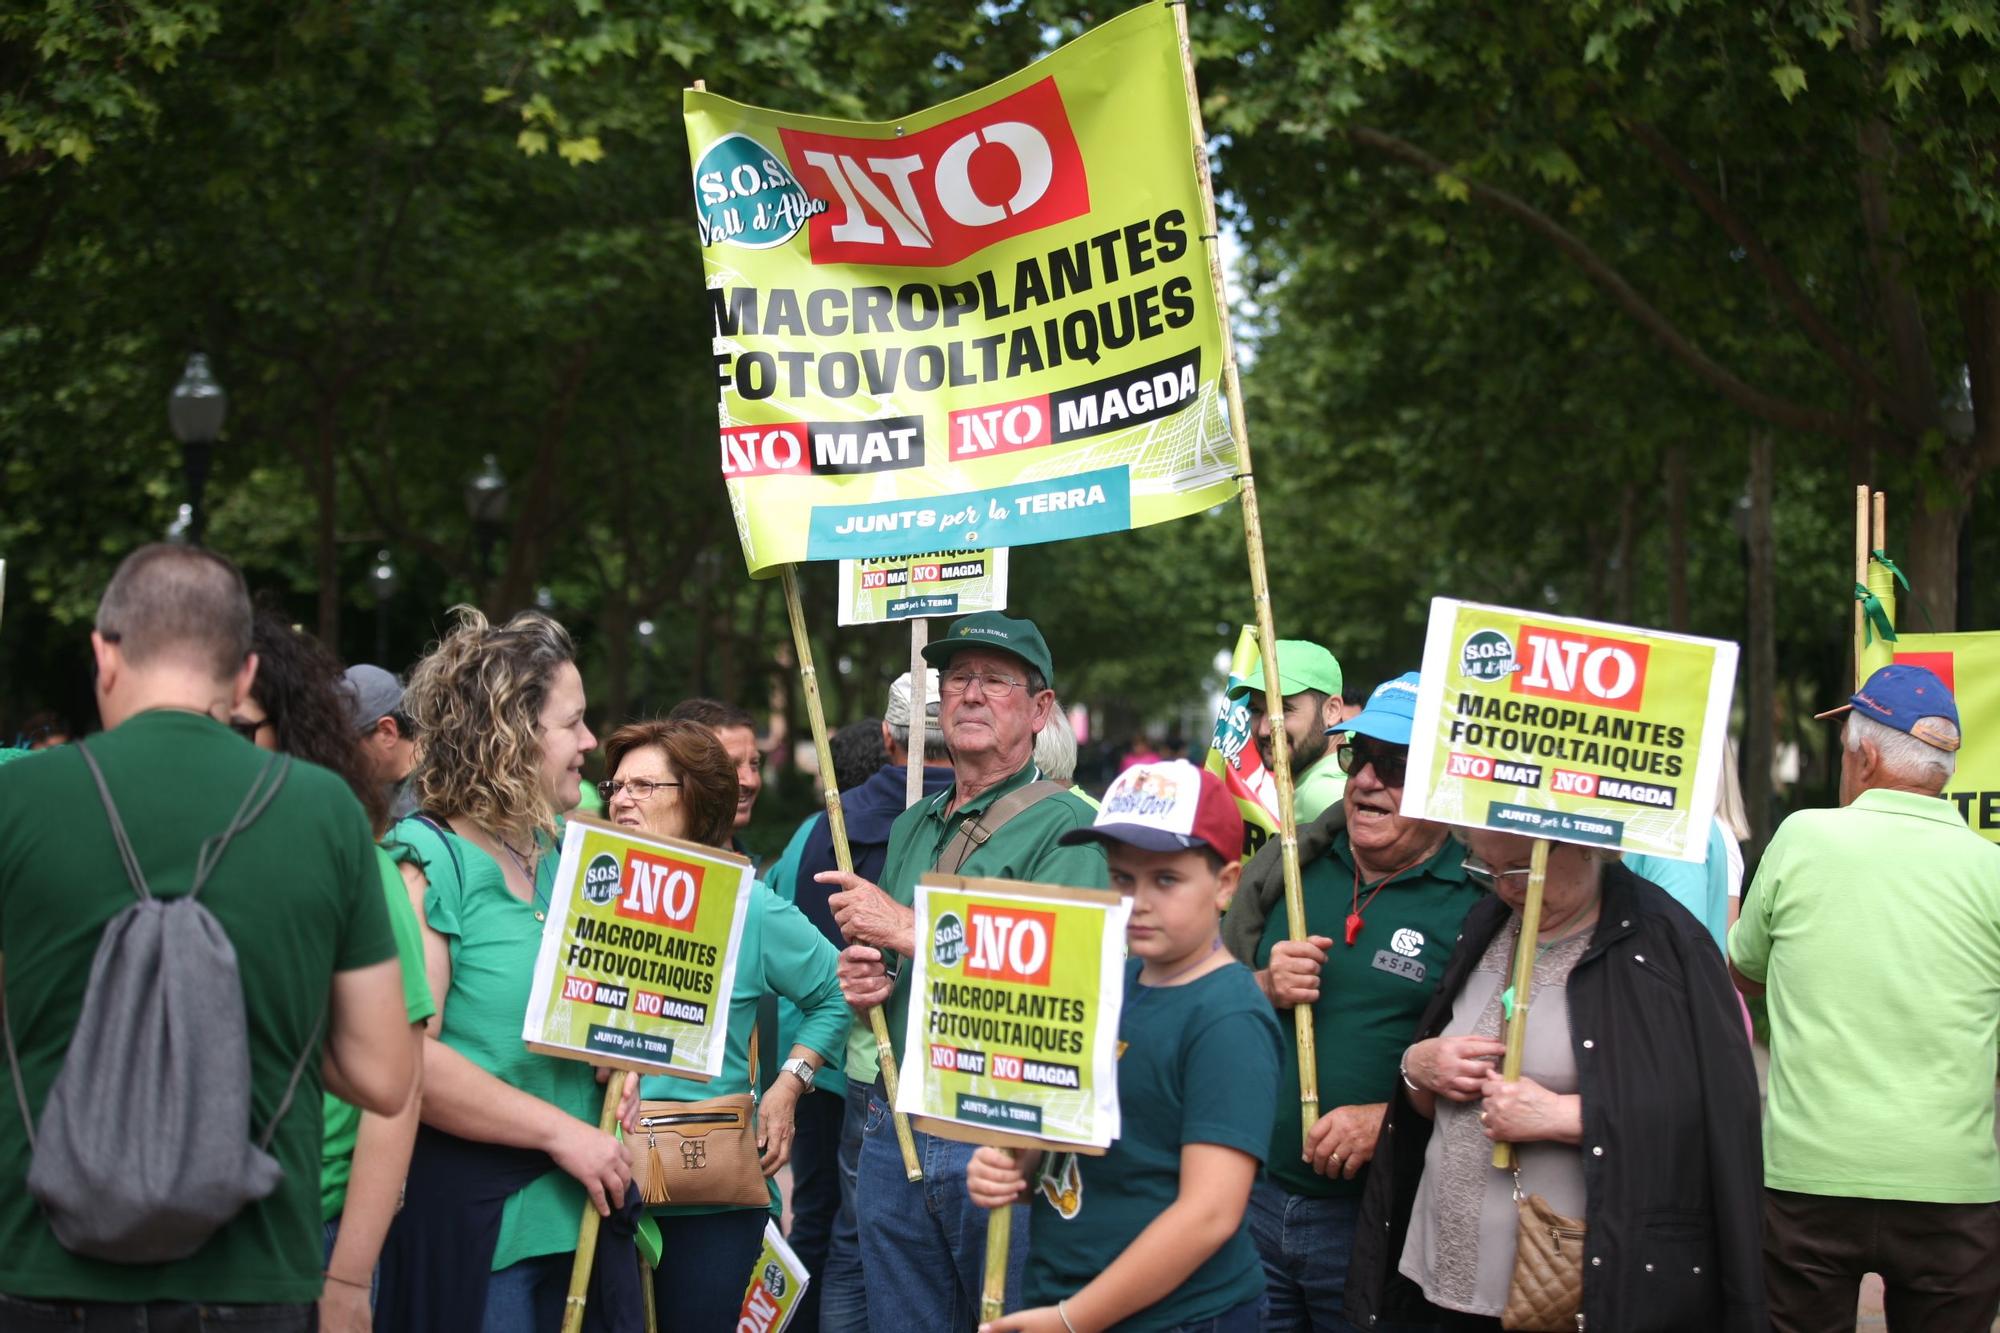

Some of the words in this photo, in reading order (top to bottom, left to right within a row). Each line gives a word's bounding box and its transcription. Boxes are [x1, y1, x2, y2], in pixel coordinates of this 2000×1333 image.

[699, 159, 792, 207] S.O.S.
[803, 121, 1053, 248] NO
[699, 207, 745, 246] Vall
[753, 192, 828, 231] d'Alba
[706, 209, 1187, 338] MACROPLANTES
[713, 276, 1195, 402] FOTOVOLTAIQUES
[957, 404, 1042, 454] NO
[1058, 363, 1196, 434] MAGDA
[720, 430, 802, 474] NO
[814, 428, 917, 465] MAT
[835, 509, 936, 534] JUNTS
[939, 504, 981, 531] per
[988, 498, 1011, 521] la
[1015, 484, 1106, 516] TERRA
[863, 572, 885, 587] NO
[913, 566, 938, 580] NO
[942, 563, 983, 579] MAGDA
[1521, 635, 1637, 700] NO
[1457, 693, 1685, 749] MACROPLANTES
[1450, 720, 1683, 778] FOTOVOLTAIQUES
[1450, 755, 1490, 779] NO
[1493, 764, 1540, 785] MAT
[1553, 771, 1594, 795] NO
[1597, 780, 1674, 807] MAGDA
[1497, 809, 1541, 824] JUNTS
[1573, 820, 1613, 836] TERRA
[588, 864, 618, 884] S.O.S.
[622, 859, 696, 921] NO
[574, 916, 718, 968] MACROPLANTES
[969, 914, 1047, 976] NO
[567, 944, 714, 995] FOTOVOLTAIQUES
[564, 979, 593, 1000] NO
[595, 987, 627, 1007] MAT
[635, 992, 661, 1014] NO
[662, 1000, 704, 1023] MAGDA
[932, 981, 1085, 1023] MACROPLANTES
[594, 1031, 623, 1046] JUNTS
[644, 1040, 667, 1054] TERRA
[929, 1010, 1083, 1055] FOTOVOLTAIQUES
[931, 1047, 956, 1069] NO
[957, 1053, 984, 1073] MAT
[992, 1057, 1021, 1079] NO
[1022, 1064, 1079, 1087] MAGDA
[961, 1100, 987, 1114] JUNTS
[1009, 1108, 1038, 1122] TERRA
